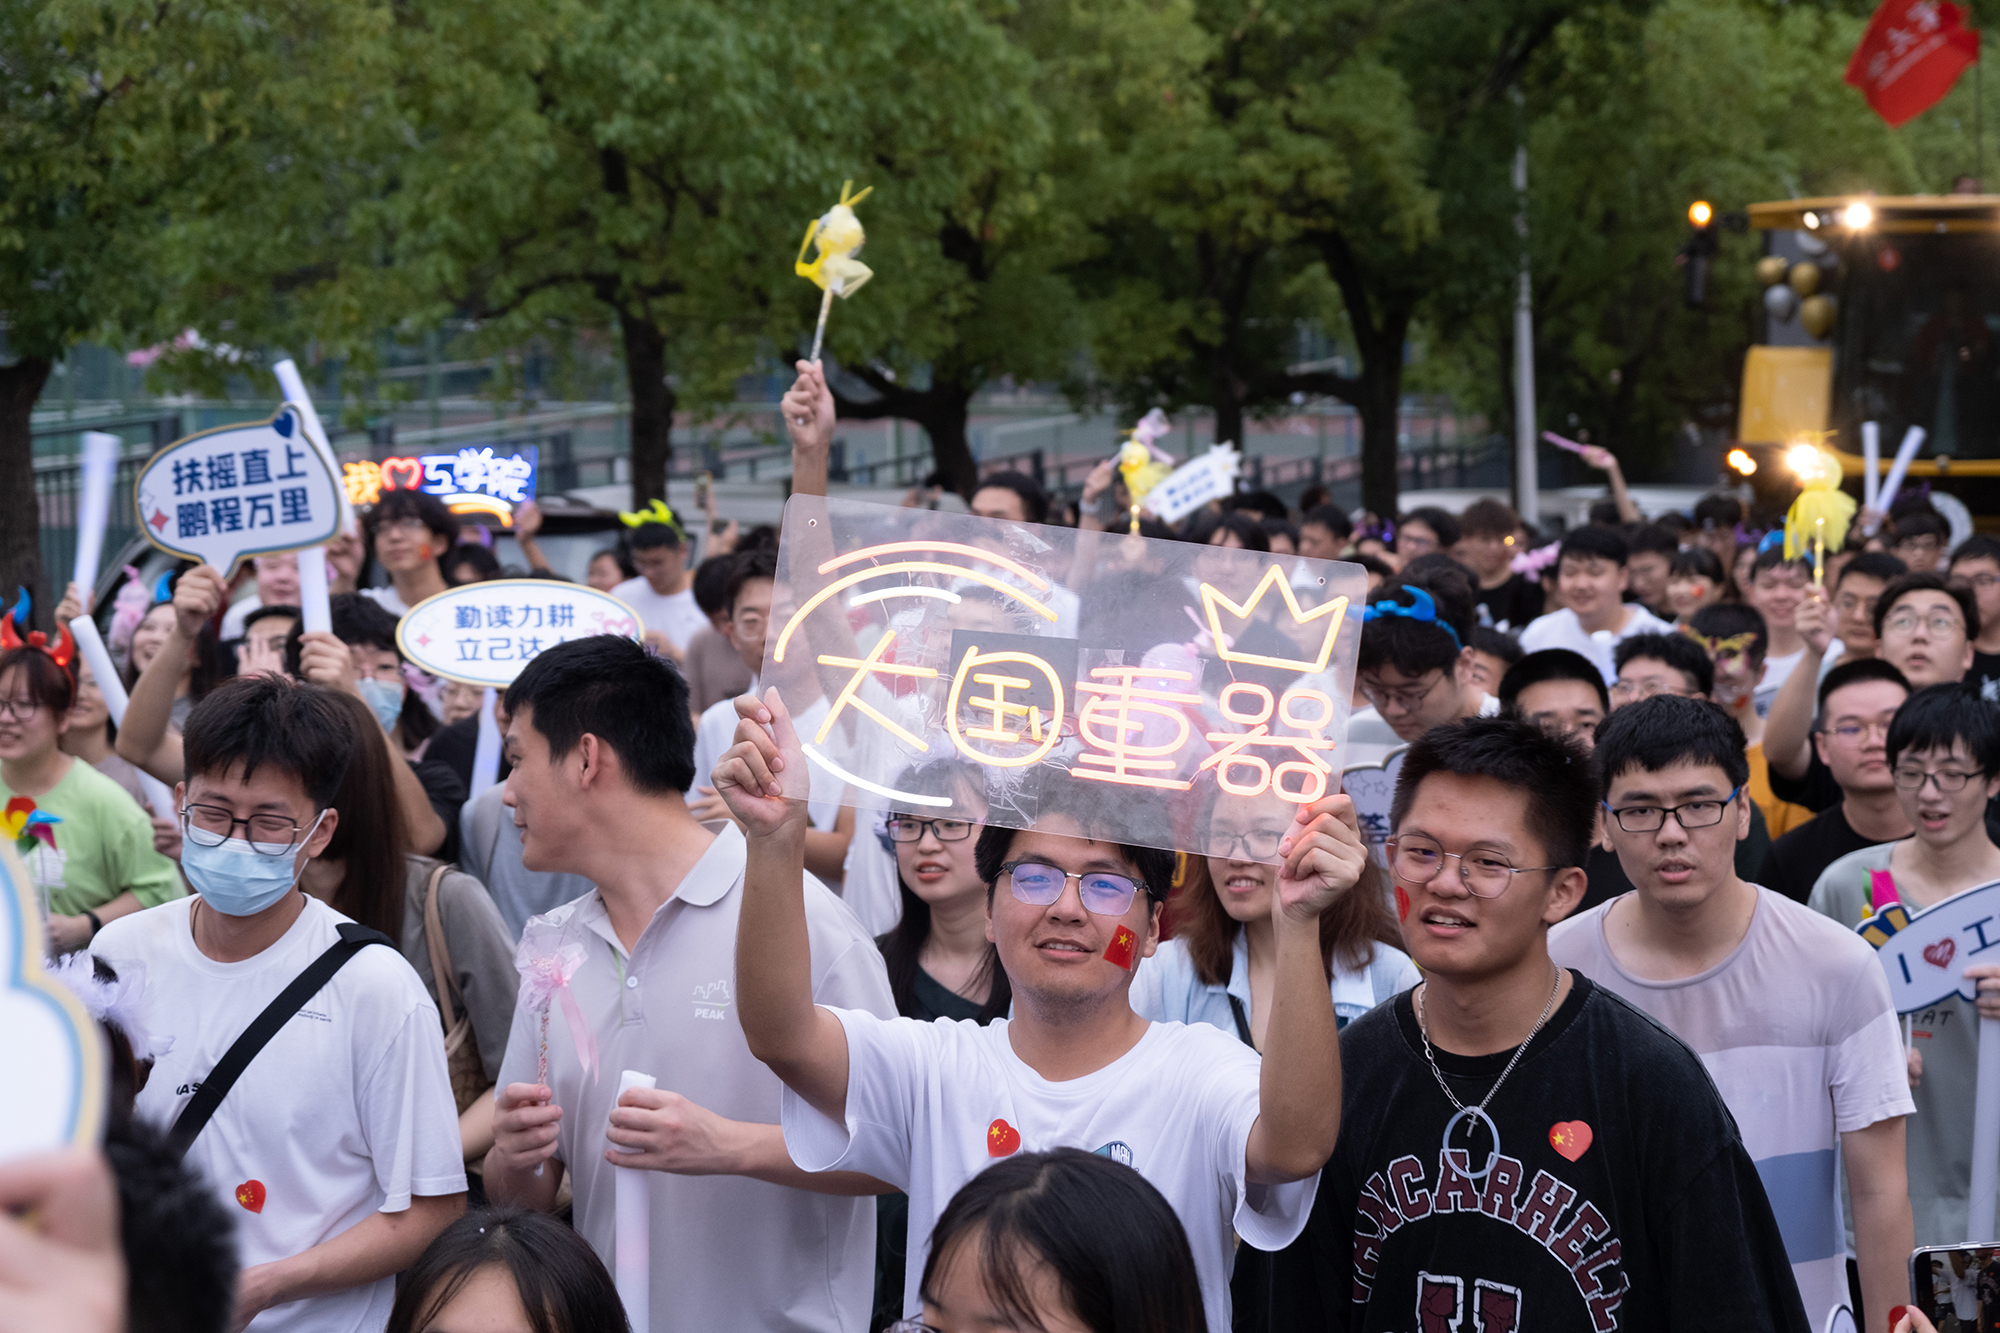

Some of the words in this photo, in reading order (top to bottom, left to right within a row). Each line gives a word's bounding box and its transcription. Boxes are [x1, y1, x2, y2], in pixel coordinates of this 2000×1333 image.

[172, 444, 307, 495] 扶摇直上
[176, 487, 312, 538] 鹏程万里
[455, 604, 575, 629] 勤读力耕
[455, 636, 569, 662] 立己达
[816, 629, 1336, 804] 大国重器
[694, 1008, 725, 1020] PEAK
